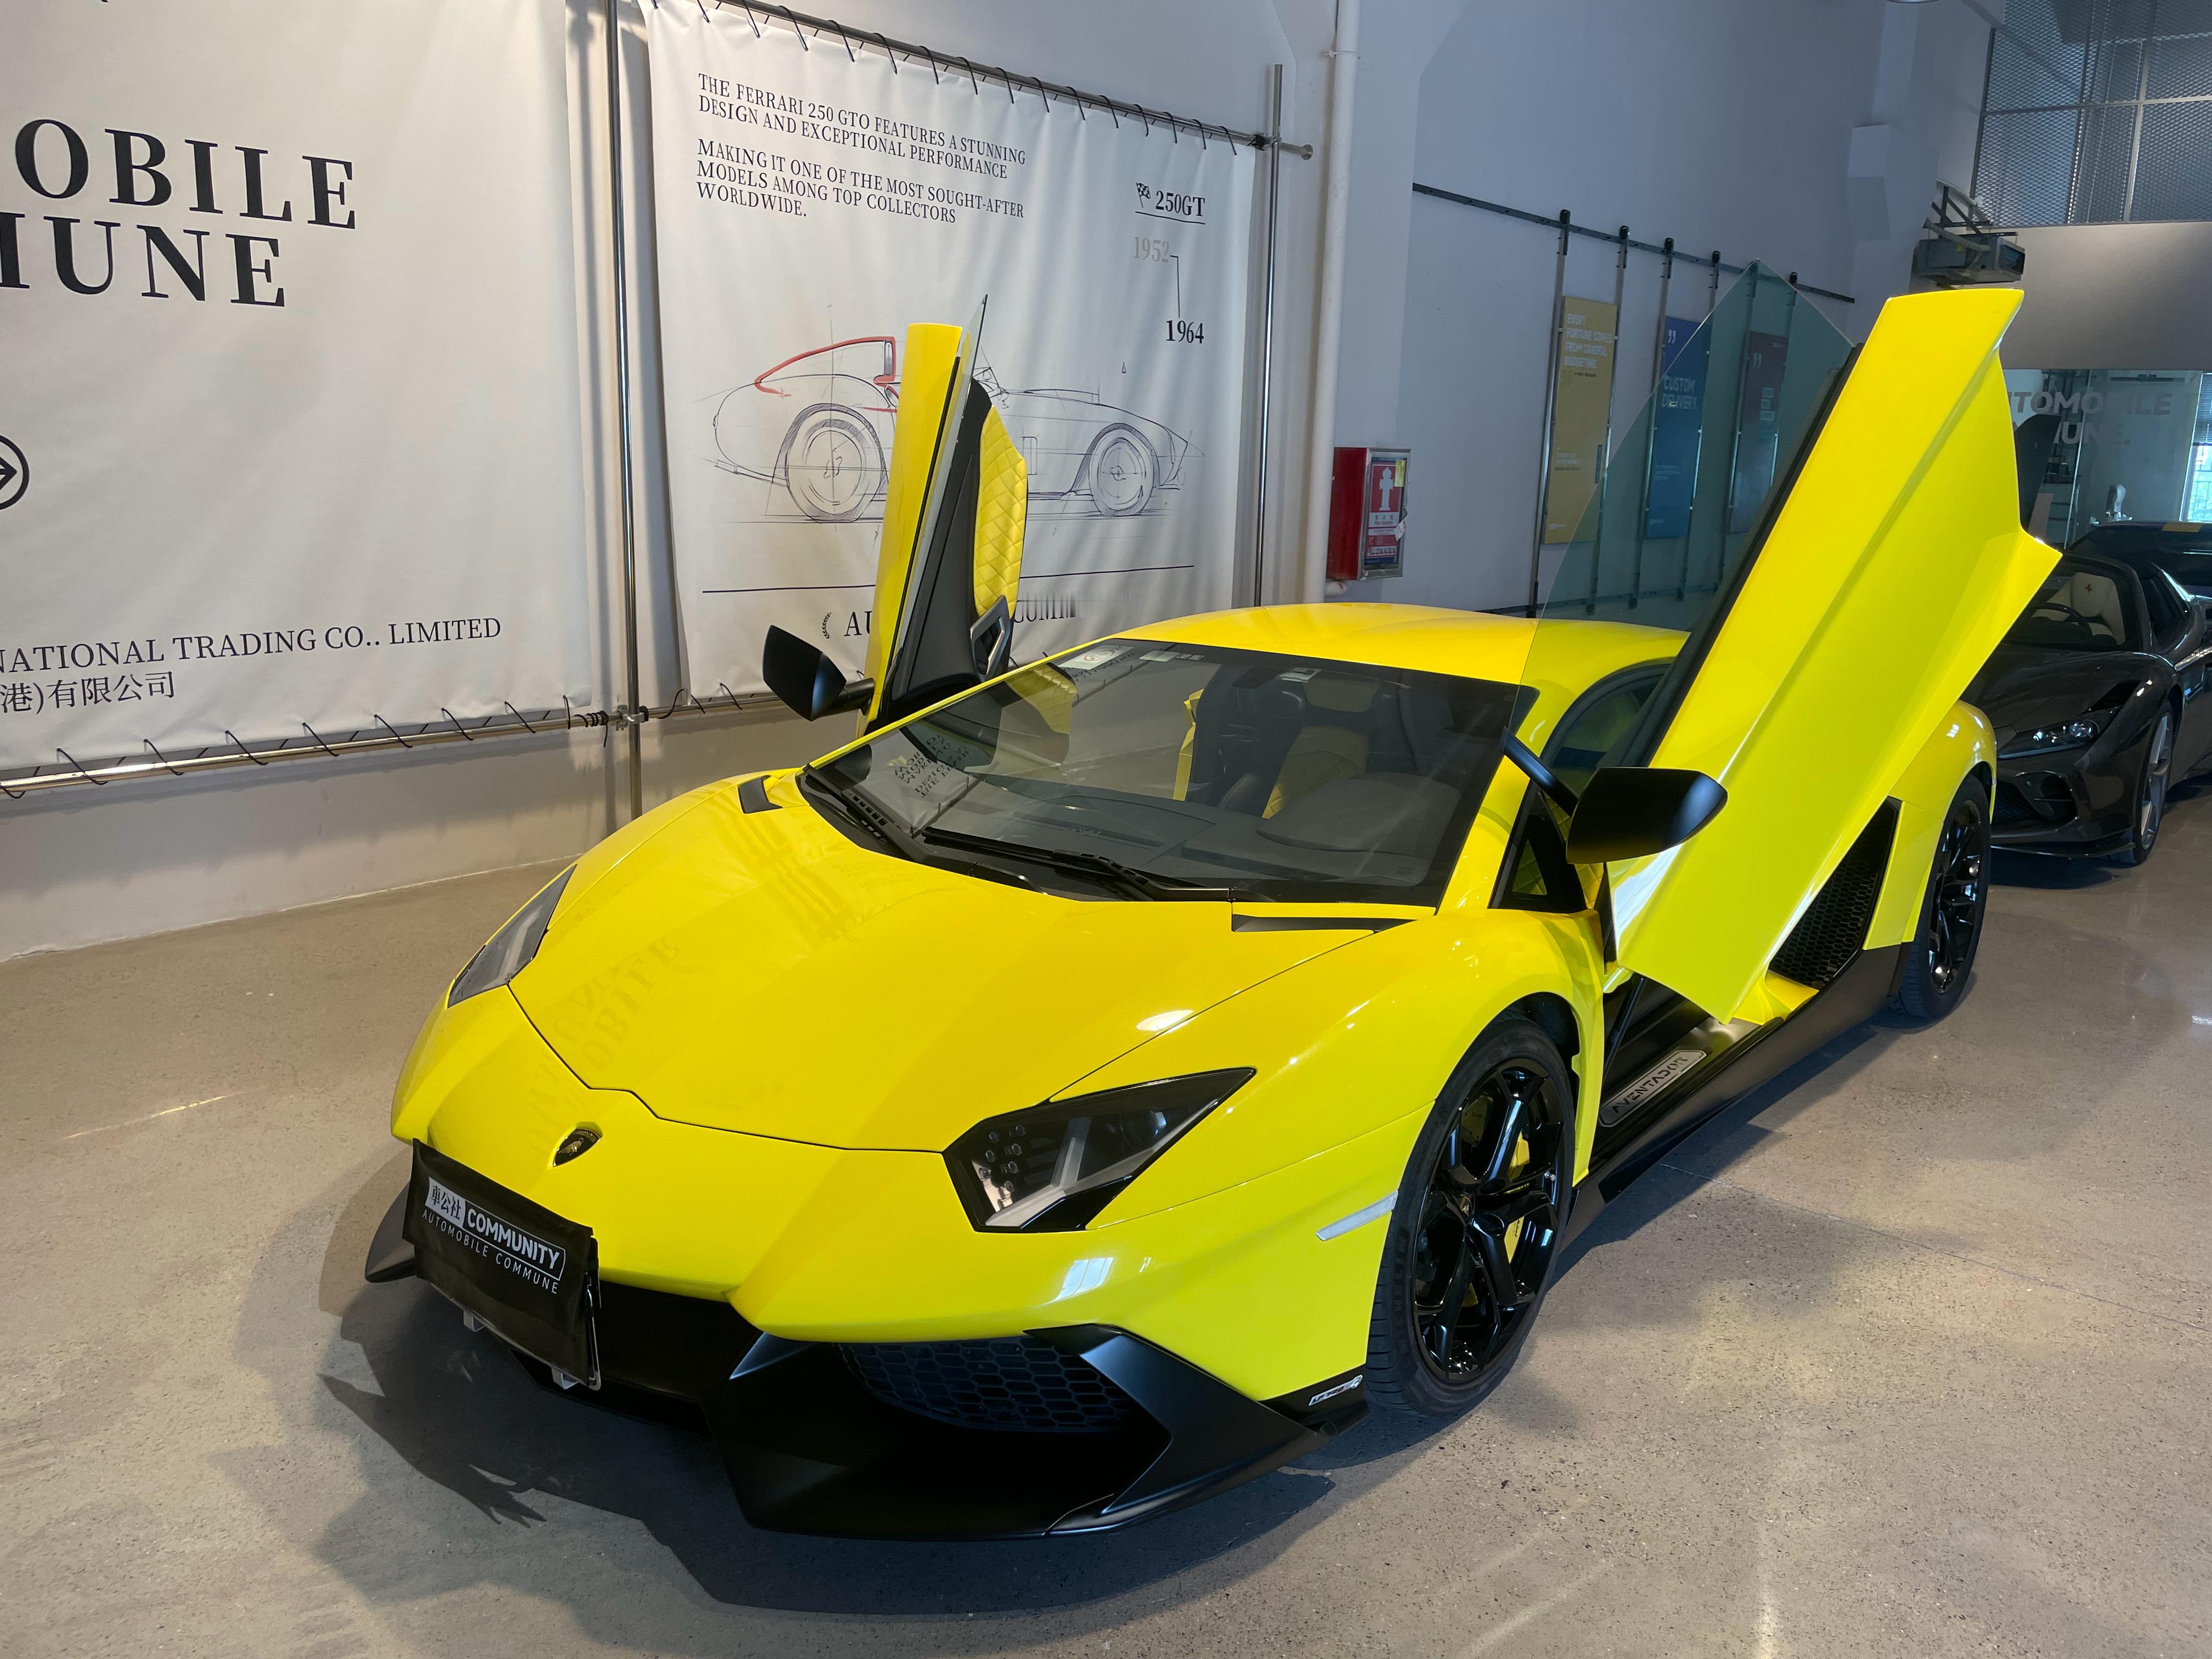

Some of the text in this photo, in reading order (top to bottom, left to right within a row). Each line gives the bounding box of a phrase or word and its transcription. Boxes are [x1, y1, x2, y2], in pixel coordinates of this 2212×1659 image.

[698, 73, 1025, 165] THE FERRARI 250 GTO FEATURES A STUNNING
[699, 95, 1007, 179] DESIGN AND EXCEPTIONAL PERFORMANCE
[15, 119, 356, 229] OBILE
[696, 182, 807, 217] WORLDWIDE.
[697, 160, 955, 223] MODELS AMONG TOP COLLECTORS
[698, 138, 1024, 218] MAKING IT ONE OF THE MOST SOUGHT-AFTER
[1155, 190, 1205, 217] 250GT
[1133, 236, 1170, 263] 1952
[1166, 320, 1204, 344] 1964
[1663, 375, 1696, 393] CUSTOM
[0, 640, 165, 673] ATIONAL
[172, 629, 317, 660] TRADING
[388, 618, 501, 645] LIMITED
[422, 1209, 558, 1295] AUTOMOBILE COMMUNE
[431, 1185, 560, 1270] 車公社 COMMUNITY
